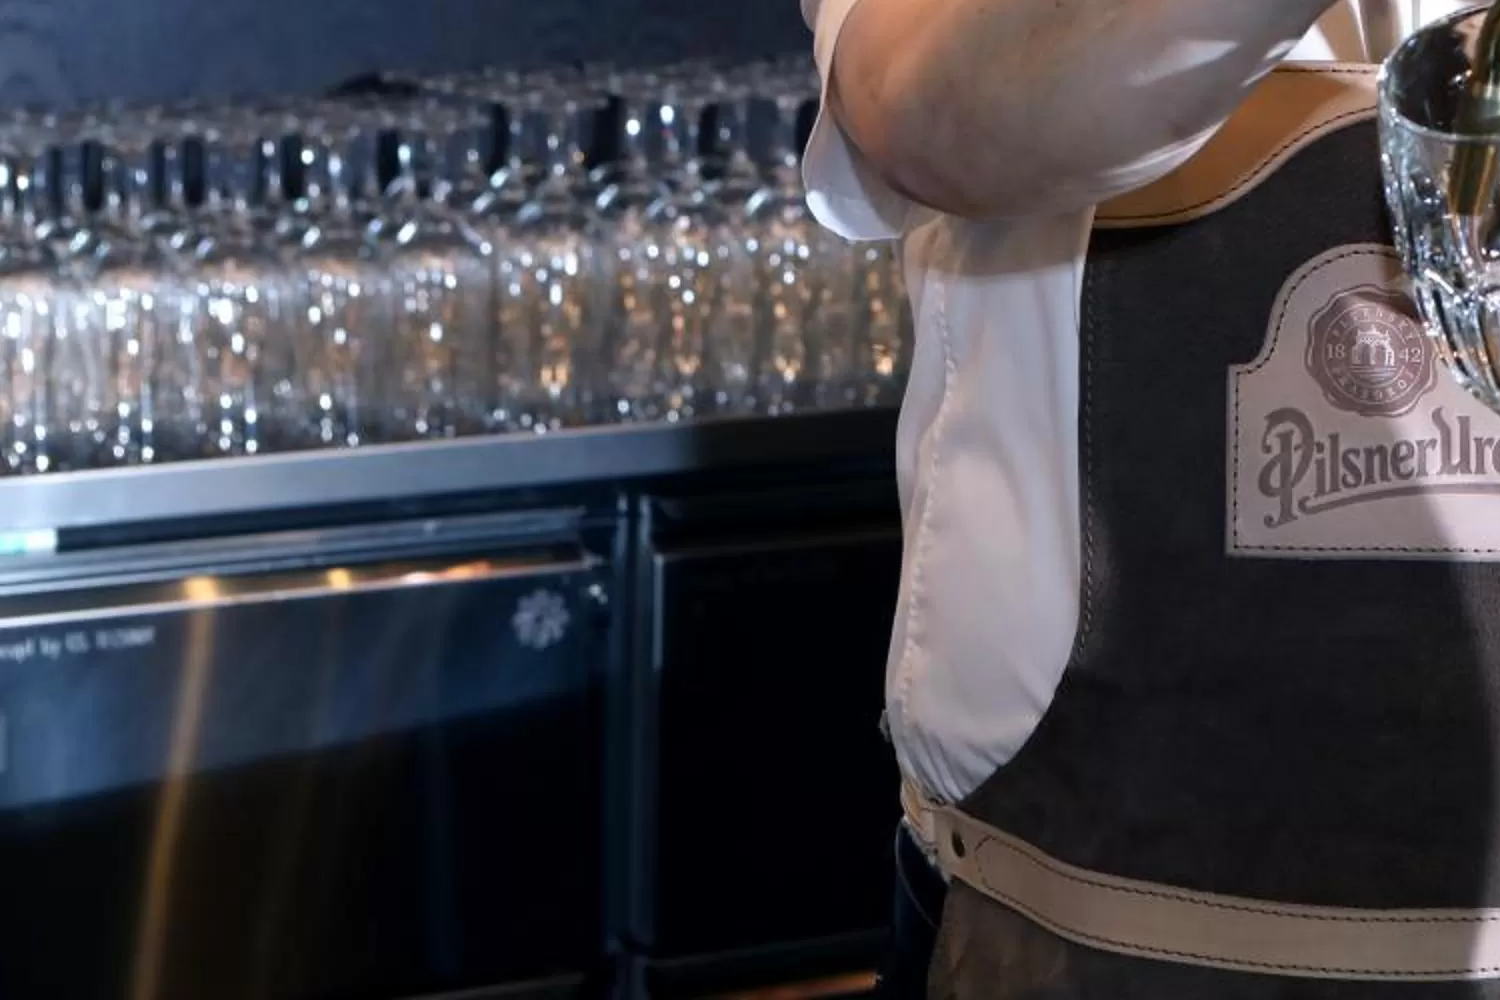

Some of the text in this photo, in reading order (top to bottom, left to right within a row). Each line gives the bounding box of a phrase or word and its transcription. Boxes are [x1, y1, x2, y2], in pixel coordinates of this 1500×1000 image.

[1326, 343, 1422, 363] 18 42
[1257, 406, 1438, 529] Pilsner
